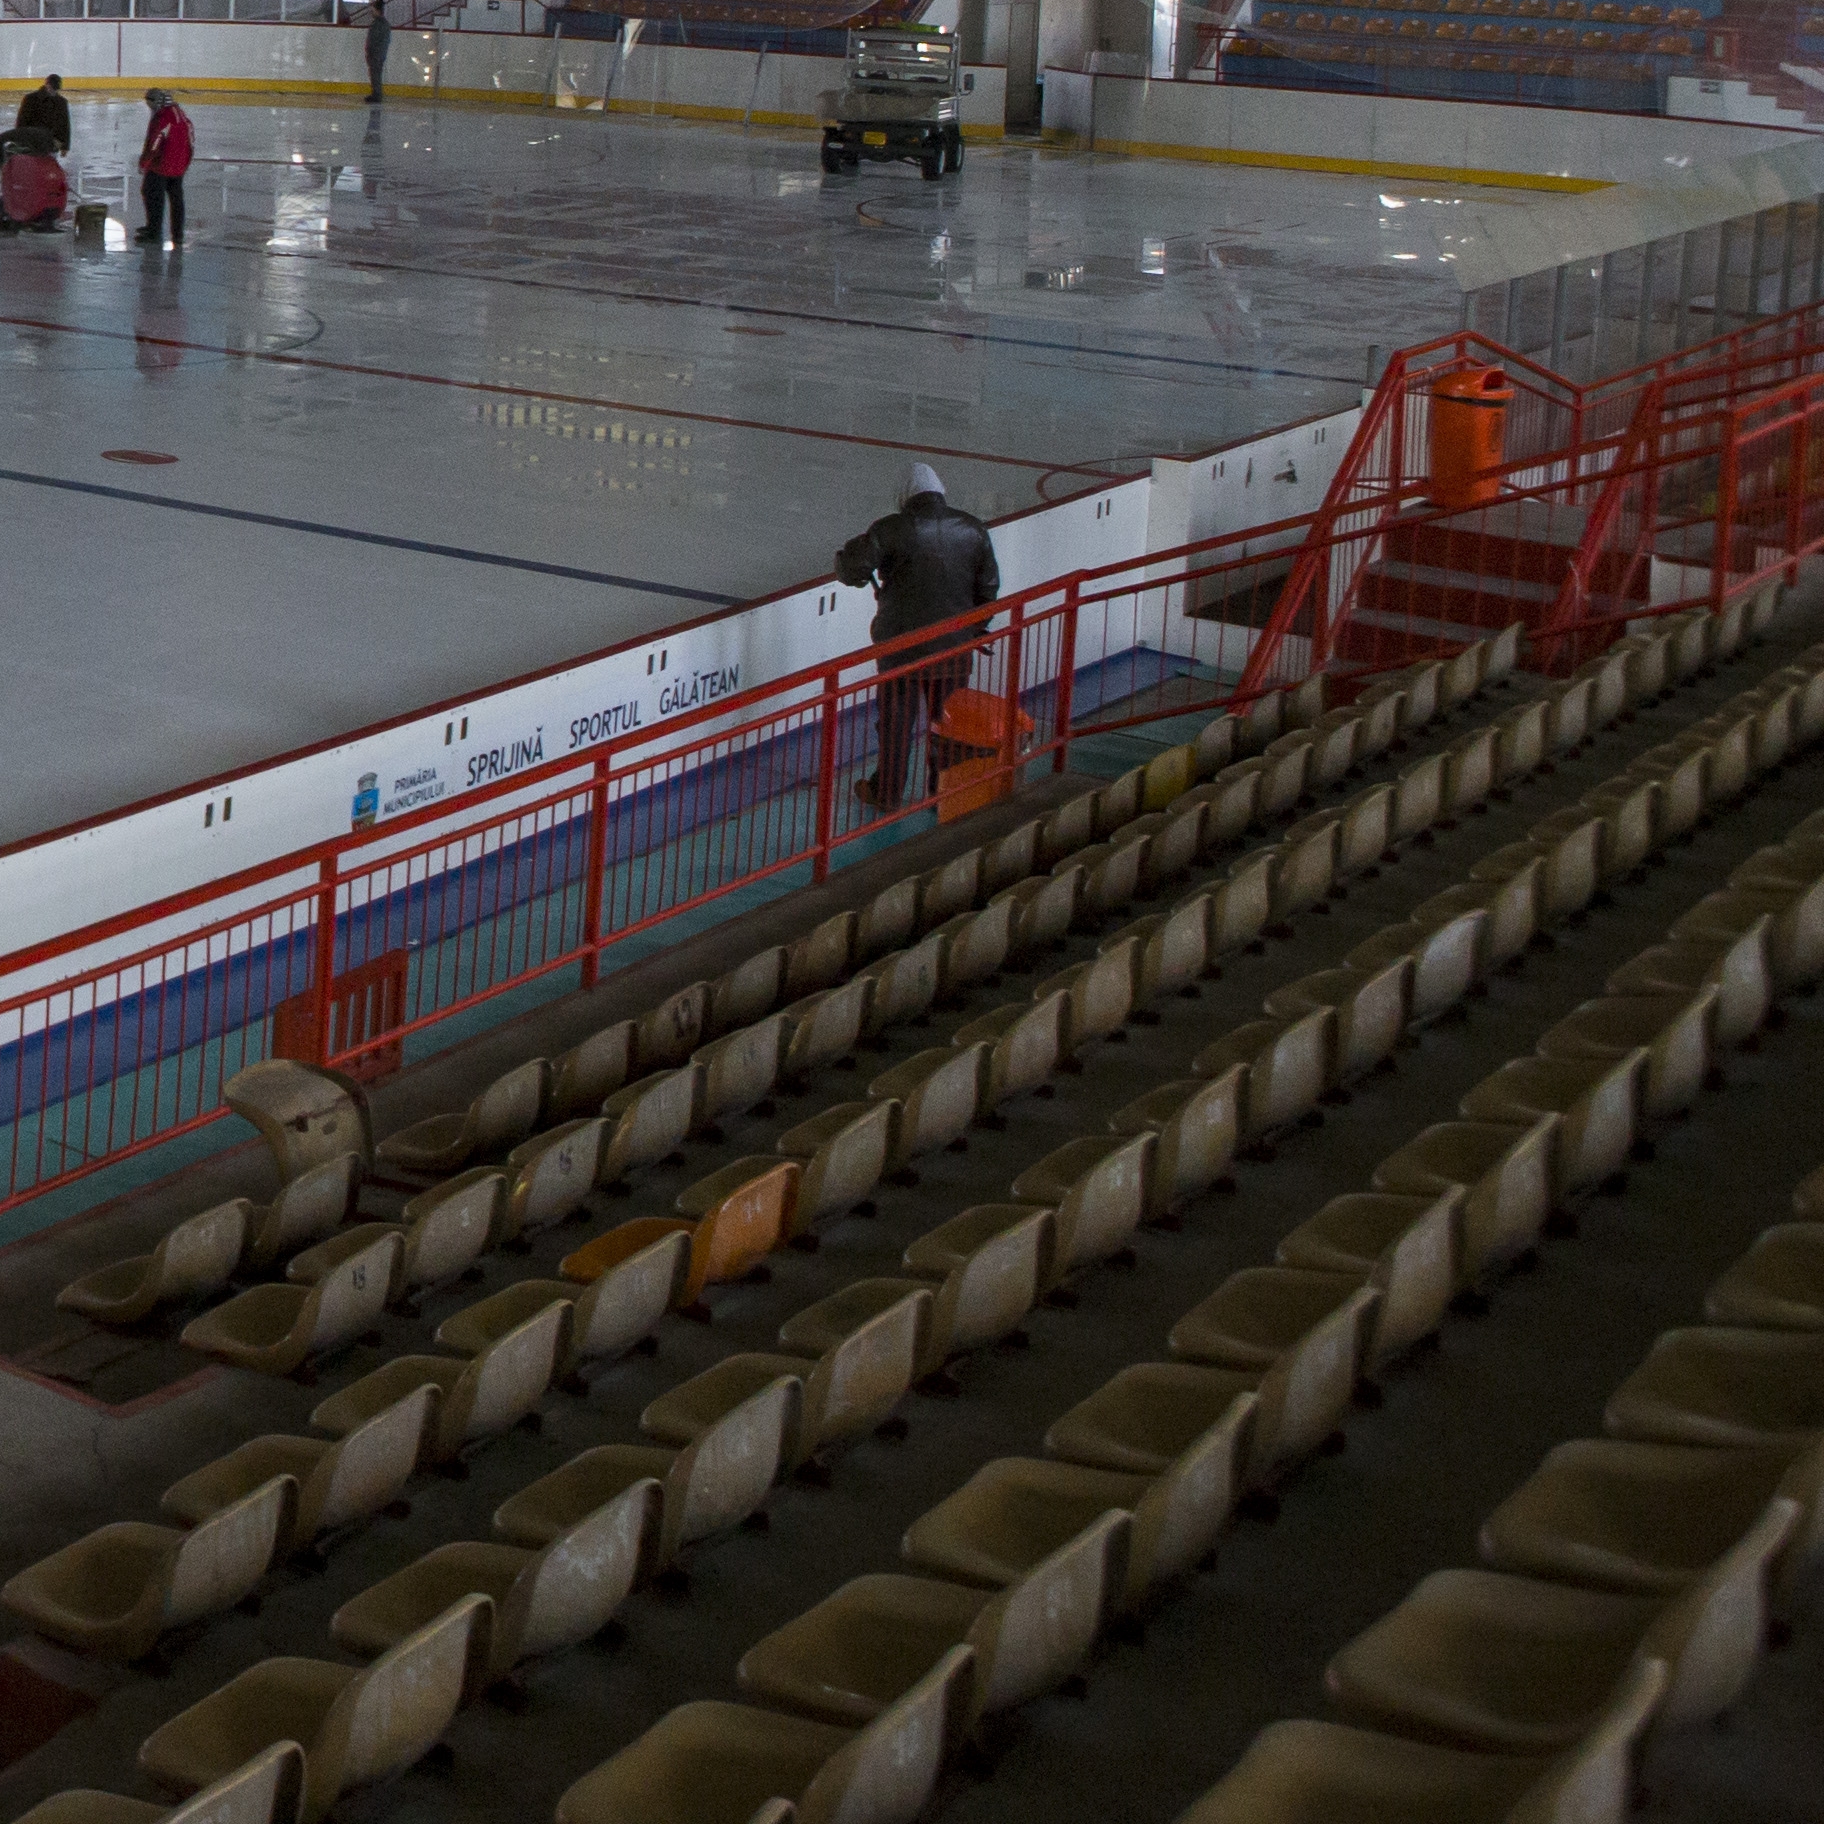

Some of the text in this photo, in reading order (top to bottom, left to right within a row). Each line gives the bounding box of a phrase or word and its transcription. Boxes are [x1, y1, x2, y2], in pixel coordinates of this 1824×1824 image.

[466, 663, 740, 786] SPRIJINĂ SPORTUL GĂLĂȚEAN
